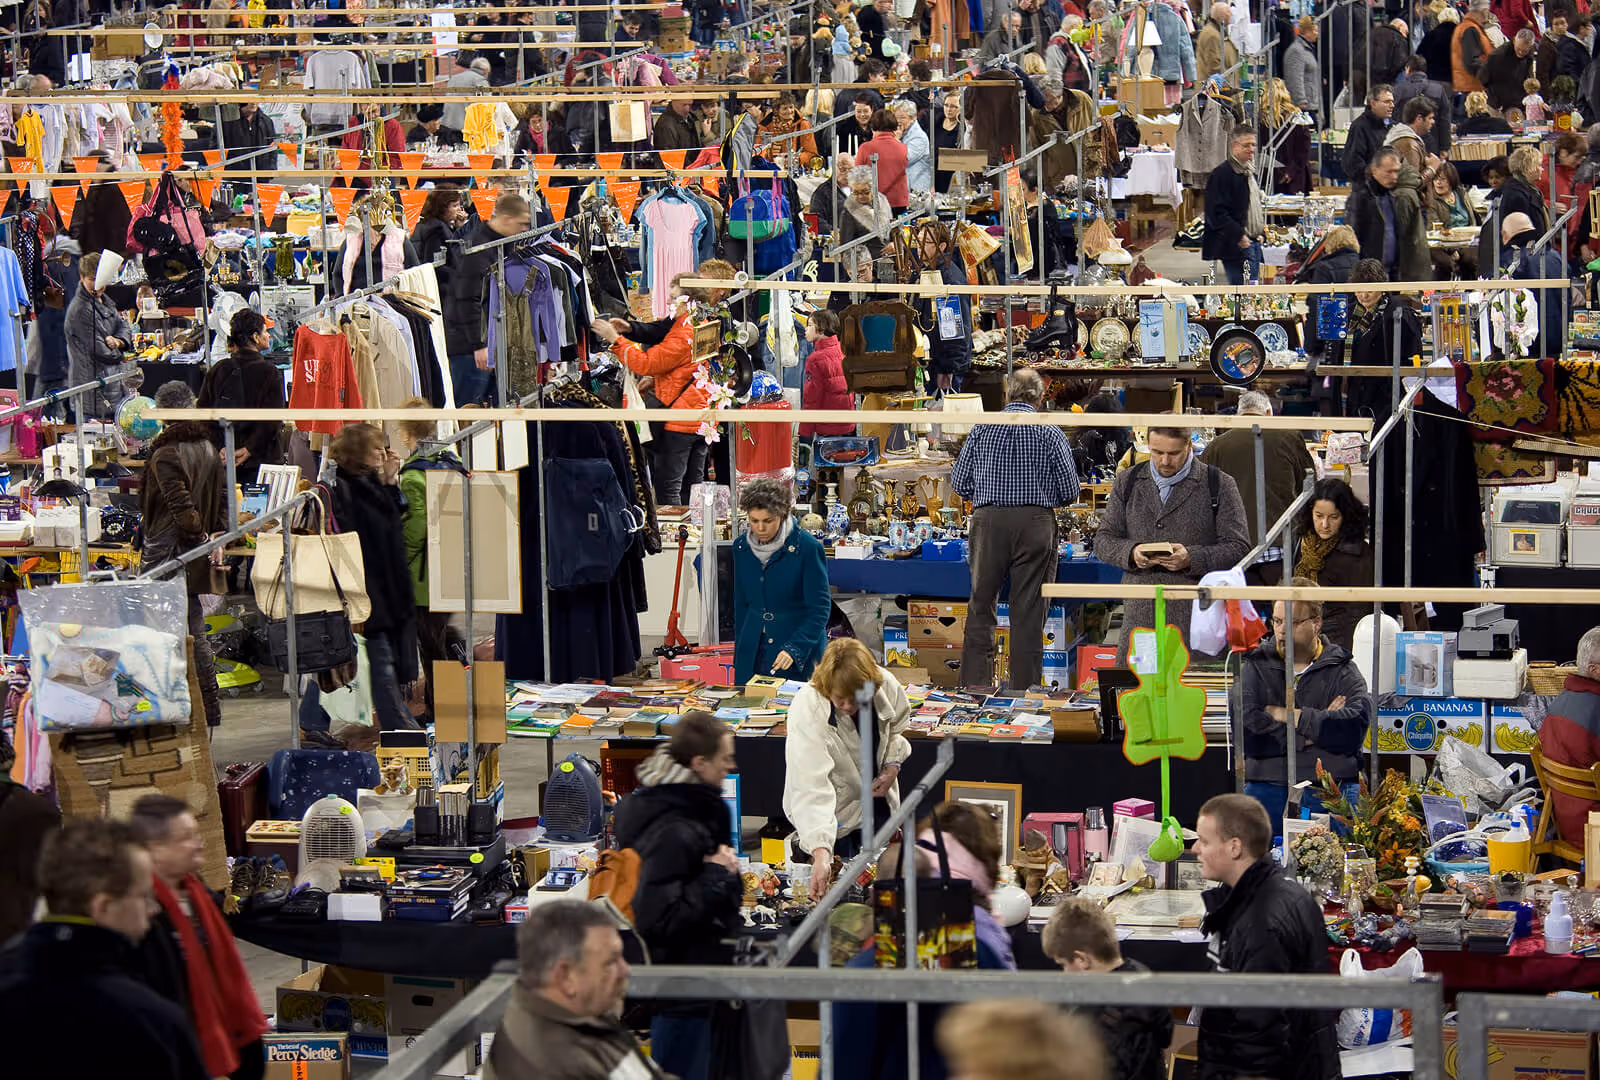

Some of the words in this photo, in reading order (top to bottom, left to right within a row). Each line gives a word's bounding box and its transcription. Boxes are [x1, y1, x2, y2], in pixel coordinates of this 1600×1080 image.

[910, 604, 939, 616] Dole
[1423, 703, 1474, 712] BANANAS
[1408, 731, 1433, 741] Chiquita
[268, 1045, 300, 1061] Percy
[300, 1045, 337, 1061] Sledge
